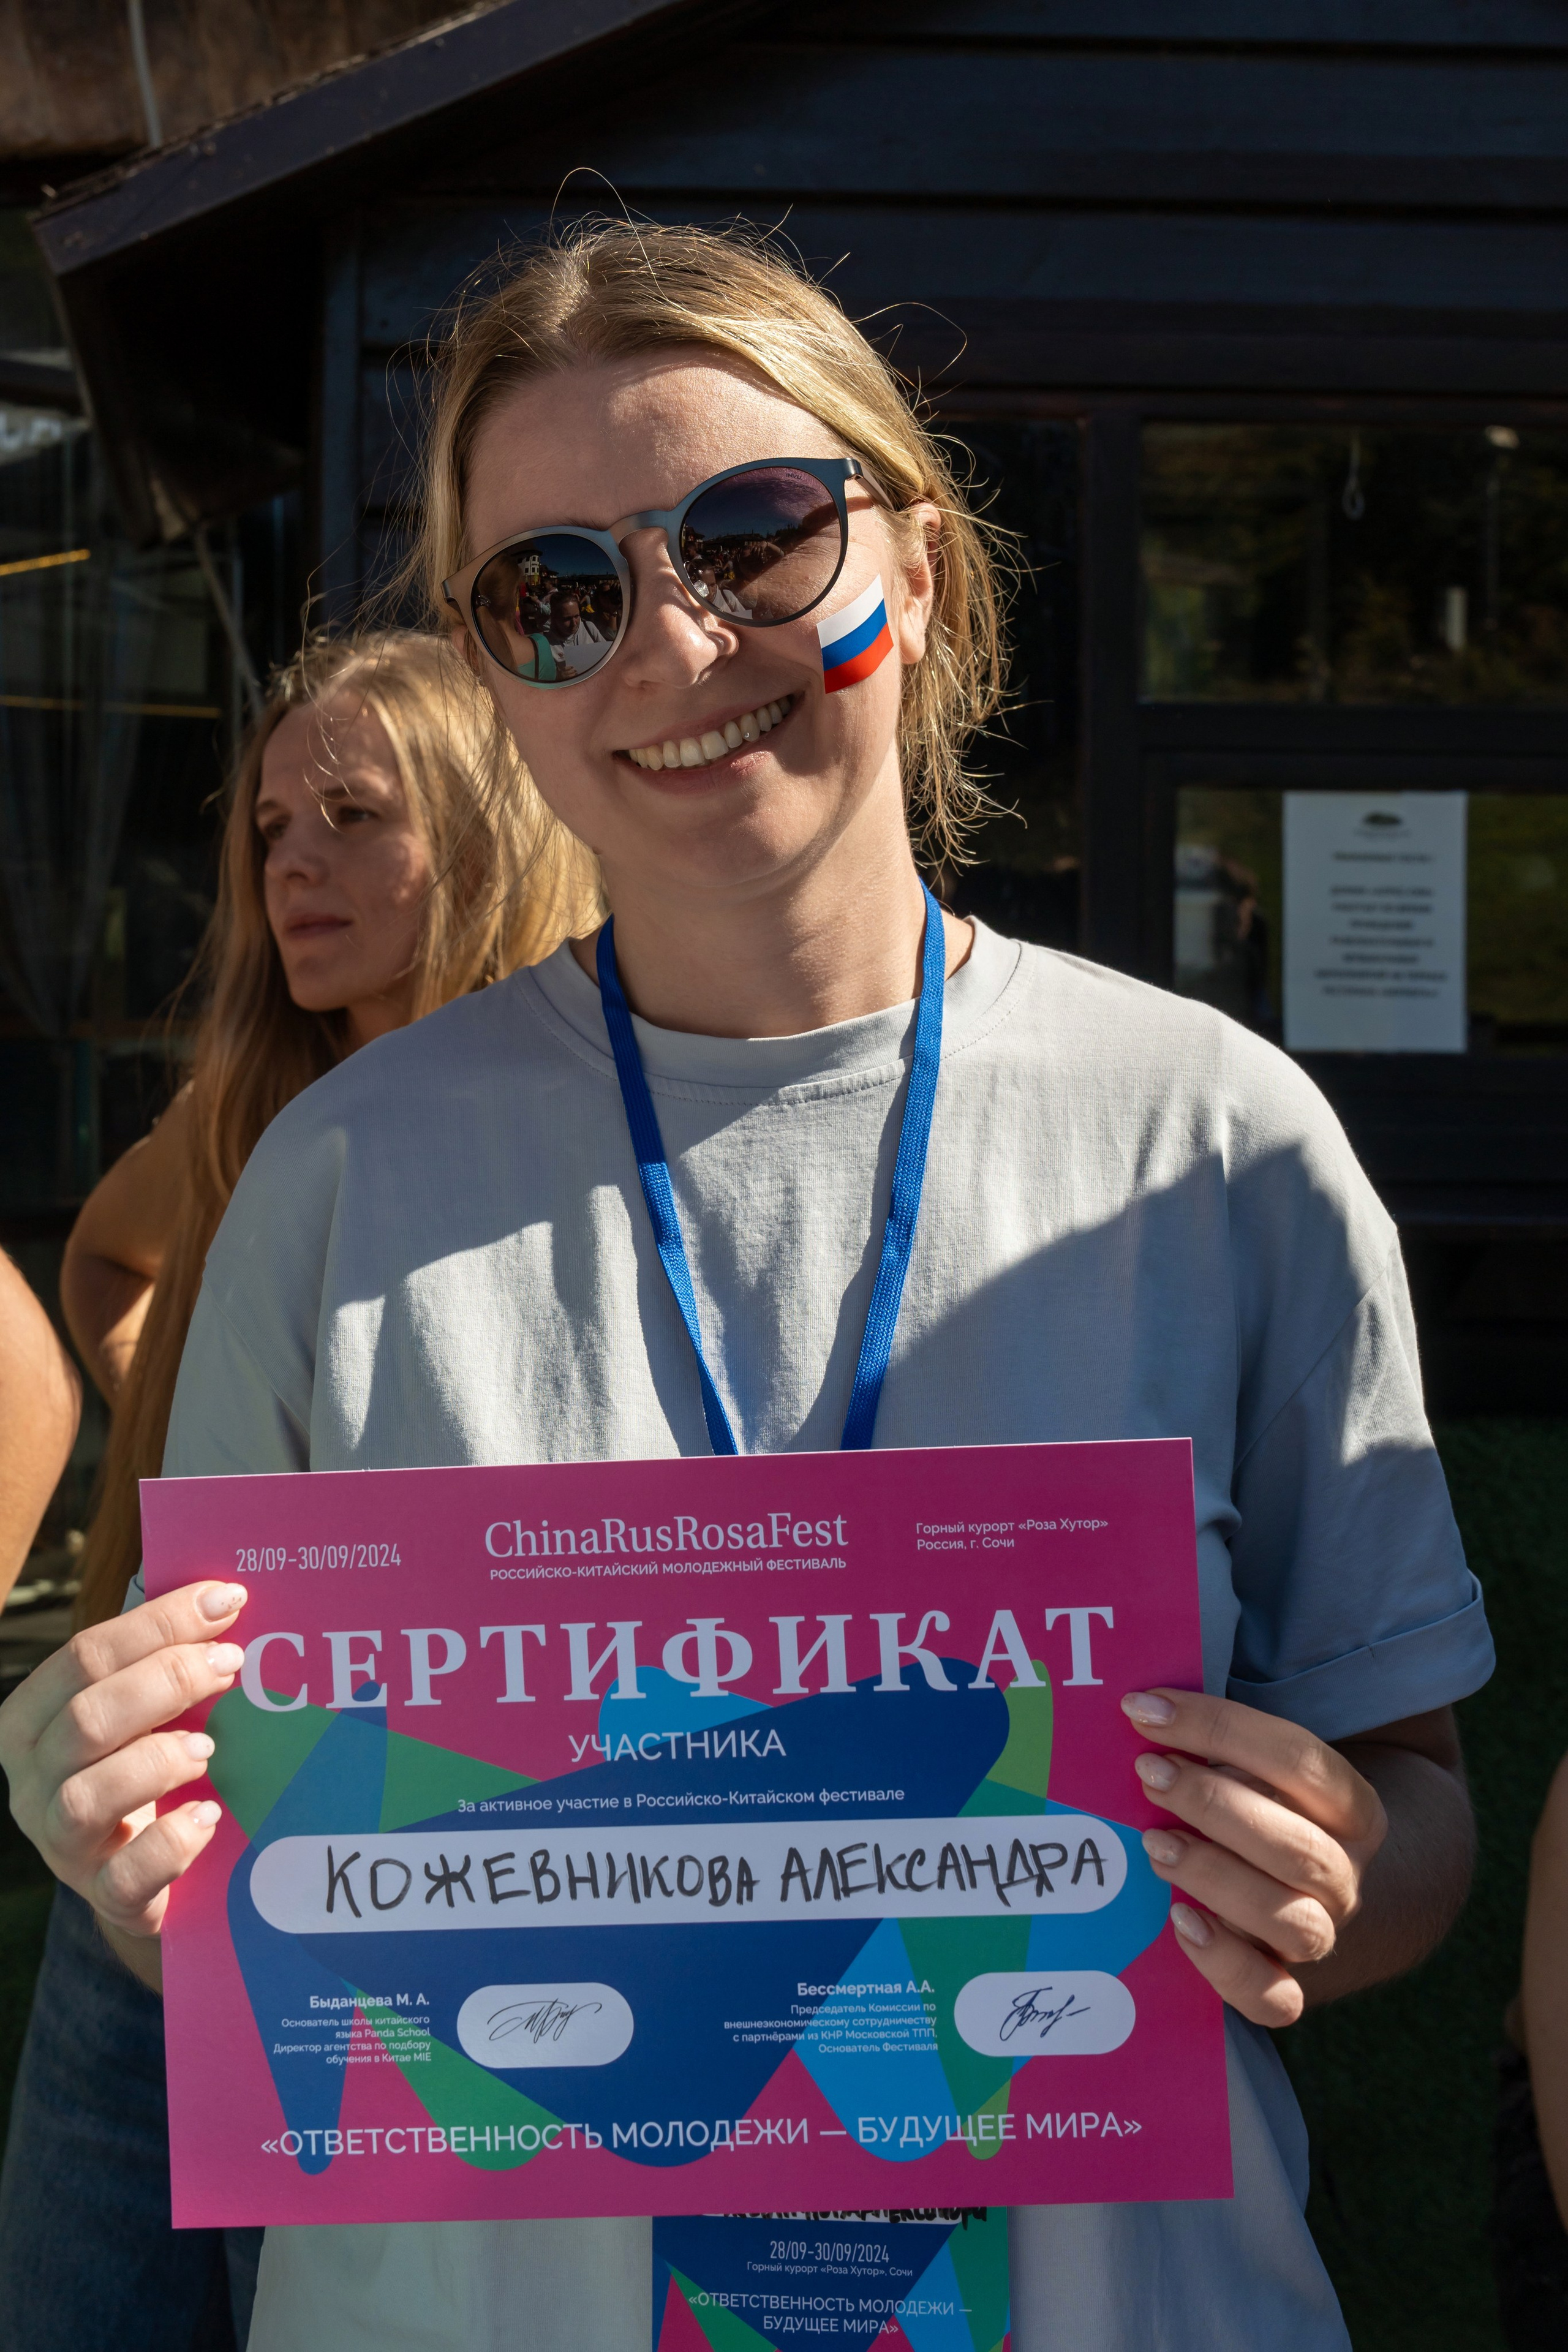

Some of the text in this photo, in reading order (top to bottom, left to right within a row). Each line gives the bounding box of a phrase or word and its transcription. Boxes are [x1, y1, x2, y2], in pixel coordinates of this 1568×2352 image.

[485, 1512, 849, 1558] ChinaRusRosaFest
[916, 1518, 1109, 1536] Горный курорт «Роза Хутор»
[916, 1537, 1015, 1550] Россия, г. Сочи
[490, 1556, 846, 1580] РОССИЙСКО-КИТАЙСКИЙ МОЛОДЕЖНЫЙ ФЕСТИВАЛЬ
[239, 1606, 1115, 1713] СЕРТИФИКАТ
[568, 1728, 786, 1762] УЧАСТНИКА
[458, 1787, 905, 1813] За активное участие в Российско-Китайском фестивале
[326, 1838, 1109, 1919] КОЖЕВНИКОВА АЛЕКСАНДРА
[797, 1980, 935, 1997] Бессмертная А.А.
[309, 1992, 429, 2010] Быданцева М. А.
[790, 2002, 936, 2015] Председатель Комиссии по
[281, 2015, 430, 2027] Основатель школы китайского
[724, 2016, 937, 2029] внешнеэкономическому сотрудничеству
[336, 2027, 431, 2039] языка Panda School
[742, 2031, 805, 2044] партнёрами
[807, 2032, 819, 2041] из
[821, 2030, 843, 2040] КНР
[846, 2028, 910, 2040] Московской
[273, 2043, 322, 2054] Директор
[323, 2042, 372, 2051] агентства
[389, 2040, 431, 2052] подбору
[818, 2042, 938, 2053] Основатель Фестиваля
[326, 2054, 371, 2066] обучения
[382, 2053, 411, 2062] Китае
[260, 2122, 602, 2155] «ОТВЕТСТВЕННОСТЬ
[612, 2118, 808, 2152] МОЛОДЕЖИ
[858, 2114, 1016, 2149] БУДУЩЕЕ
[1026, 2111, 1142, 2138] МИРА»
[747, 2261, 913, 2277] Горный курорт «Роза Хутор», Сочи
[688, 2292, 855, 2313] «ОТВЕТСТВЕННОСТЬ
[859, 2299, 954, 2318] МОЛОДЕЖИ
[763, 2315, 899, 2335] БУДУЩЕЕ МИРА»
